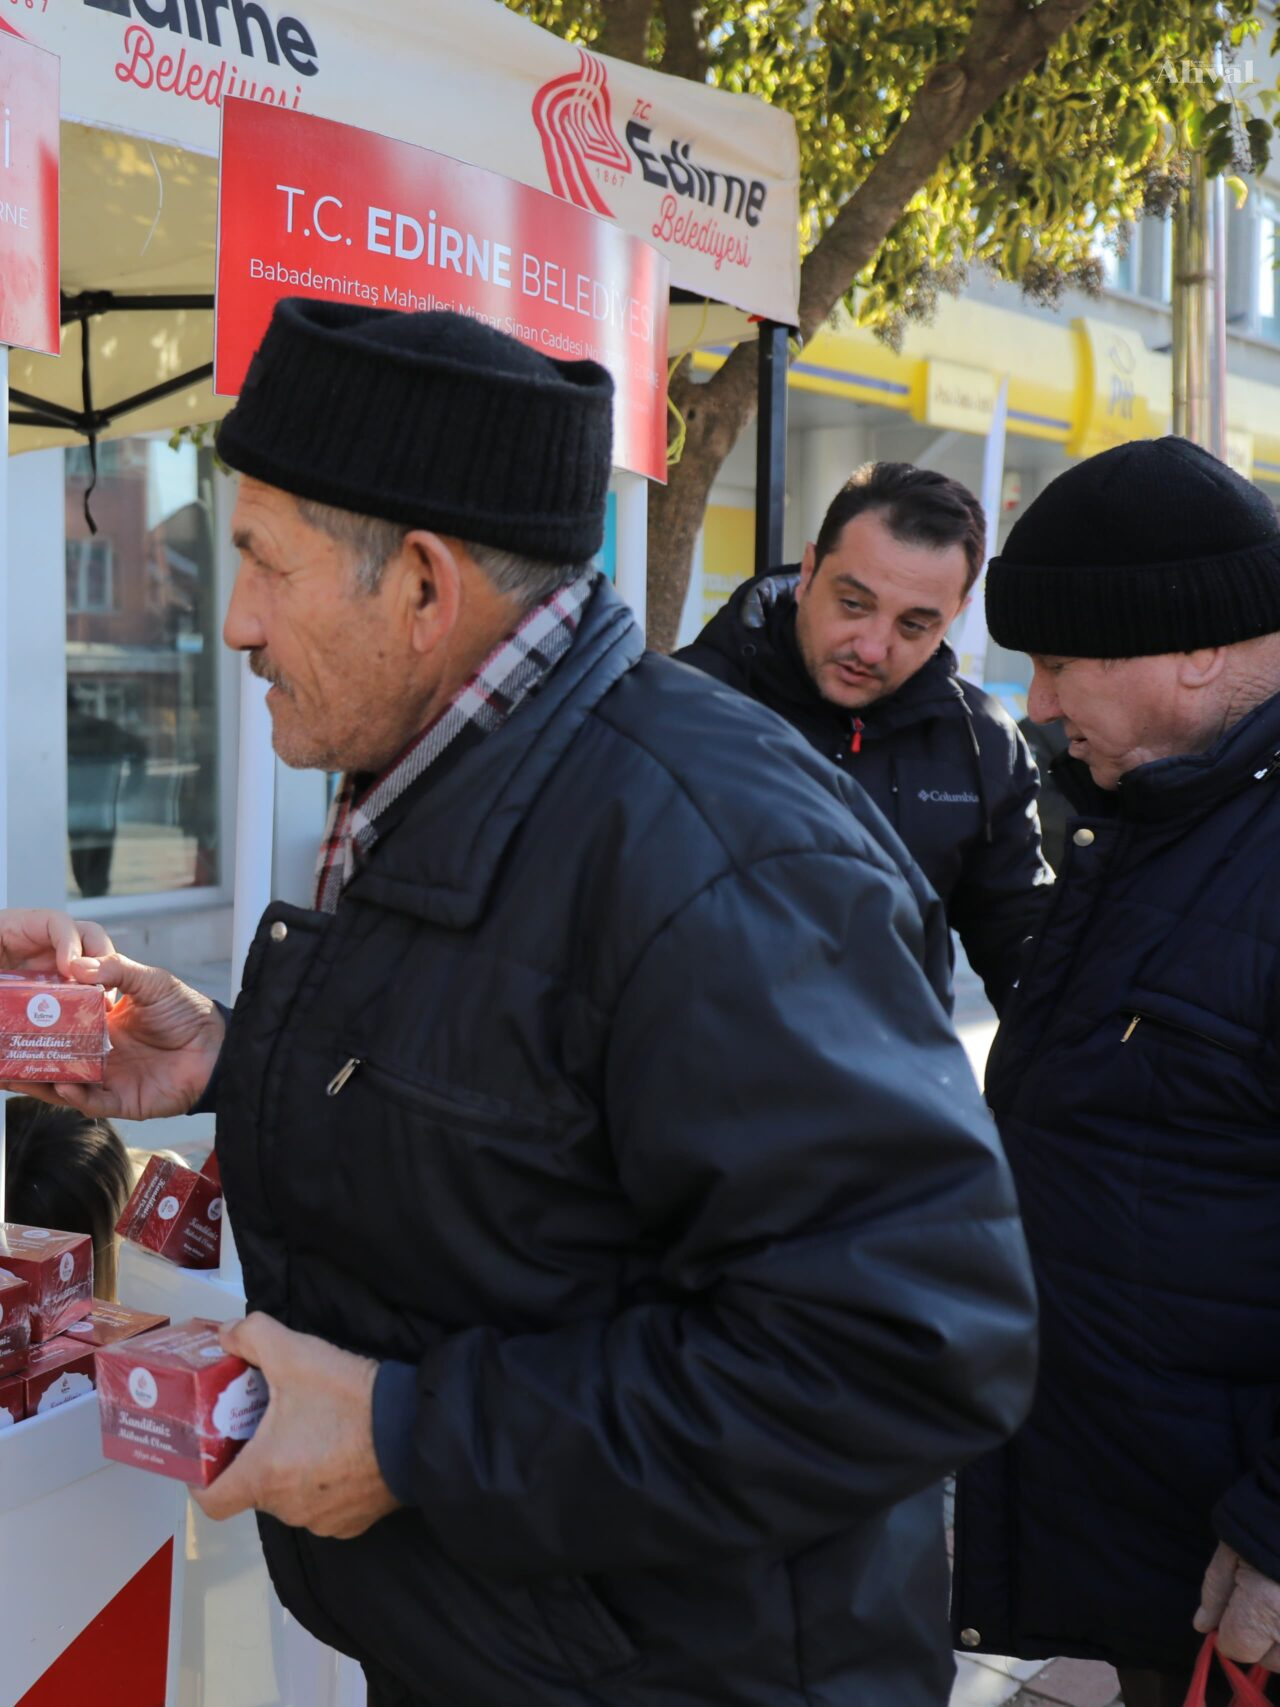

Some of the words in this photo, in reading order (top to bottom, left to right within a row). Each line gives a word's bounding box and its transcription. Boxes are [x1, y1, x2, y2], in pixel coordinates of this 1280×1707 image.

[595, 167, 626, 188] 1867
[625, 120, 767, 228] Edirne
[651, 193, 752, 272] Belediyesi
[276, 184, 352, 246] T.C.
[367, 206, 512, 288] EDİRNE
[522, 253, 654, 345] BELEDİYESİ
[249, 258, 379, 305] Babademirtaş
[503, 316, 538, 341] Sinan
[540, 328, 584, 356] Caddesi
[929, 790, 980, 803] Columbia
[9, 1035, 72, 1048] Kandiliniz
[119, 1411, 171, 1437] Kandiliniz
